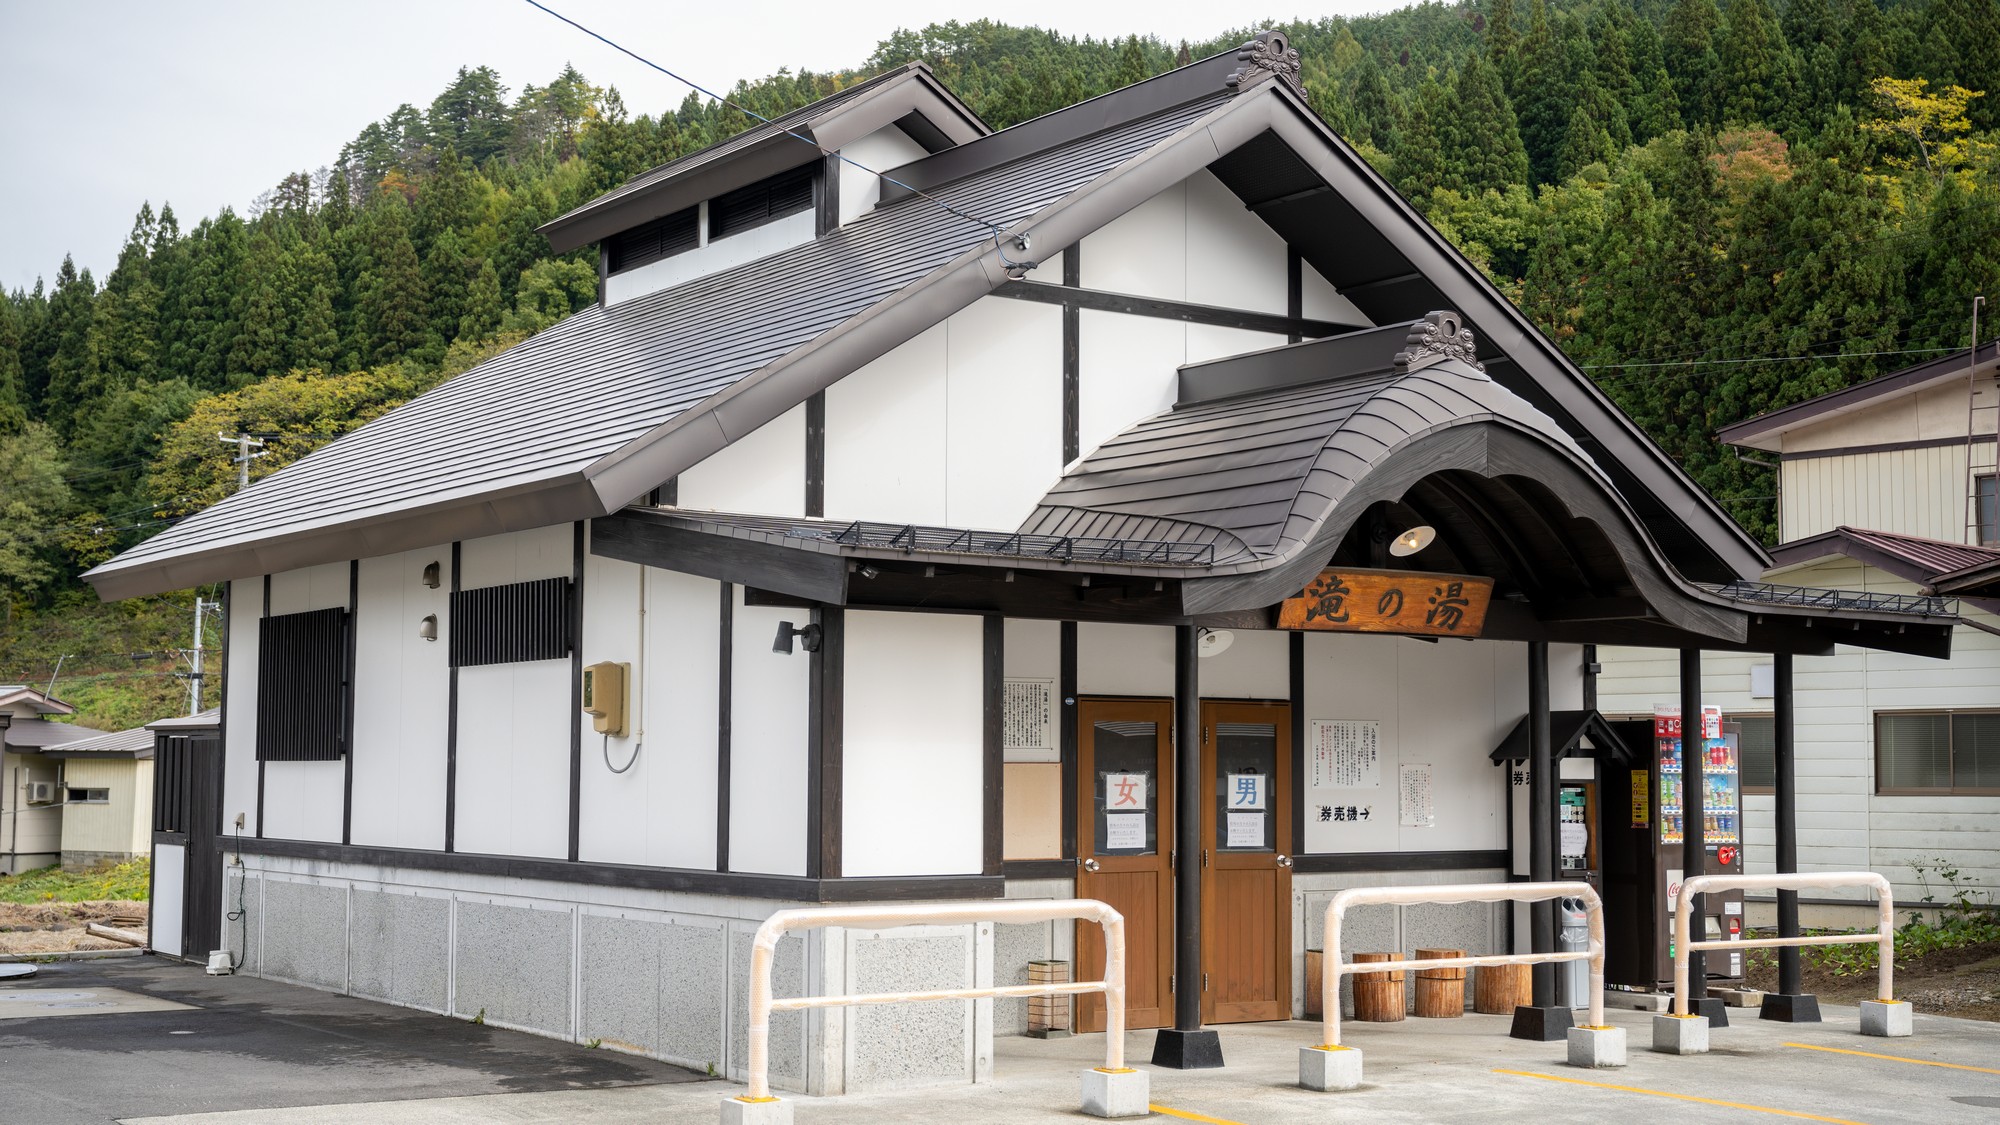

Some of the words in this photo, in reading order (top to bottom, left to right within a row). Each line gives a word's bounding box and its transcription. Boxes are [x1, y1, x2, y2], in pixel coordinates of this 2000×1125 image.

[1306, 575, 1469, 630] 滝の湯
[1114, 776, 1139, 806] 女
[1235, 777, 1257, 805] 男
[1321, 806, 1358, 821] 券売機
